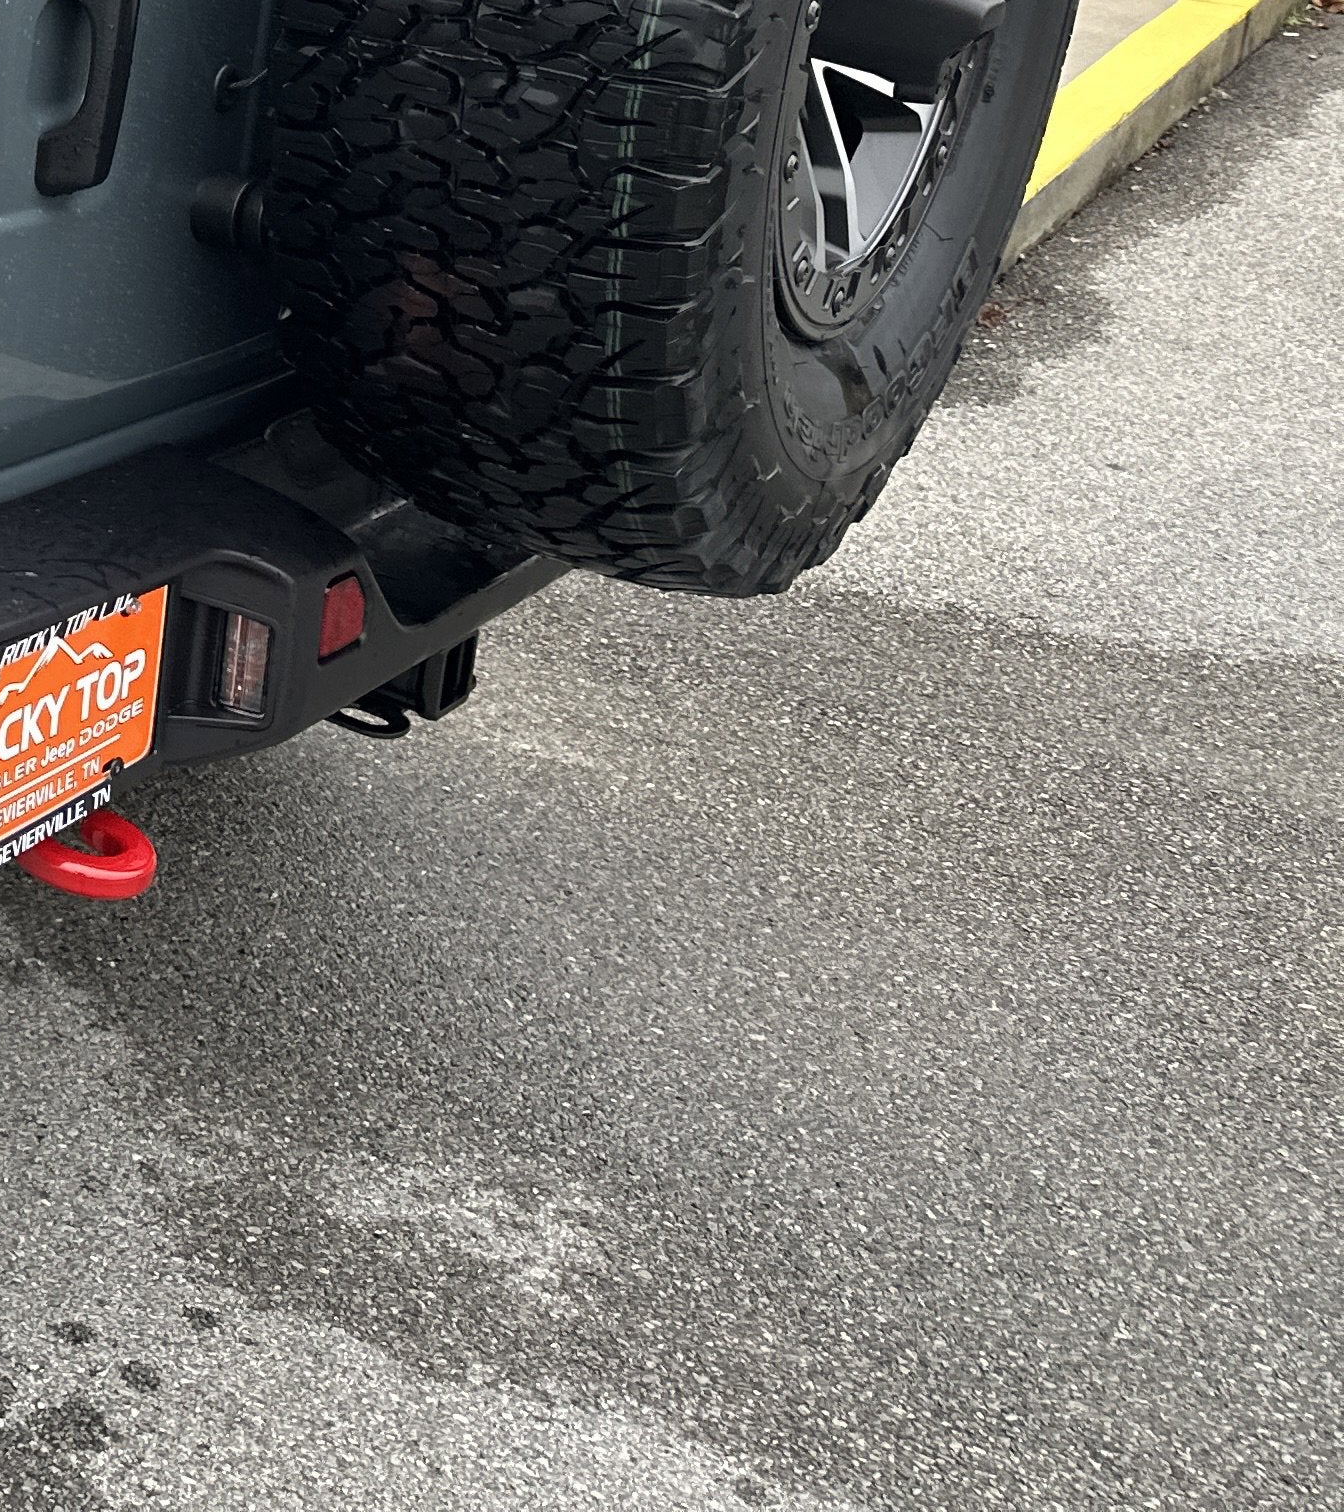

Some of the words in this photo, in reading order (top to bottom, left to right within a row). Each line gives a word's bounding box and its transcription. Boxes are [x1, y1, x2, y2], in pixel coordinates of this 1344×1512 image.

[0, 621, 62, 669] ROCKY
[63, 605, 99, 640] TOP
[75, 648, 147, 723] TOP
[40, 737, 76, 769] Jeep
[78, 697, 144, 745] DODGE
[82, 755, 101, 782] TN
[92, 784, 112, 810] TN
